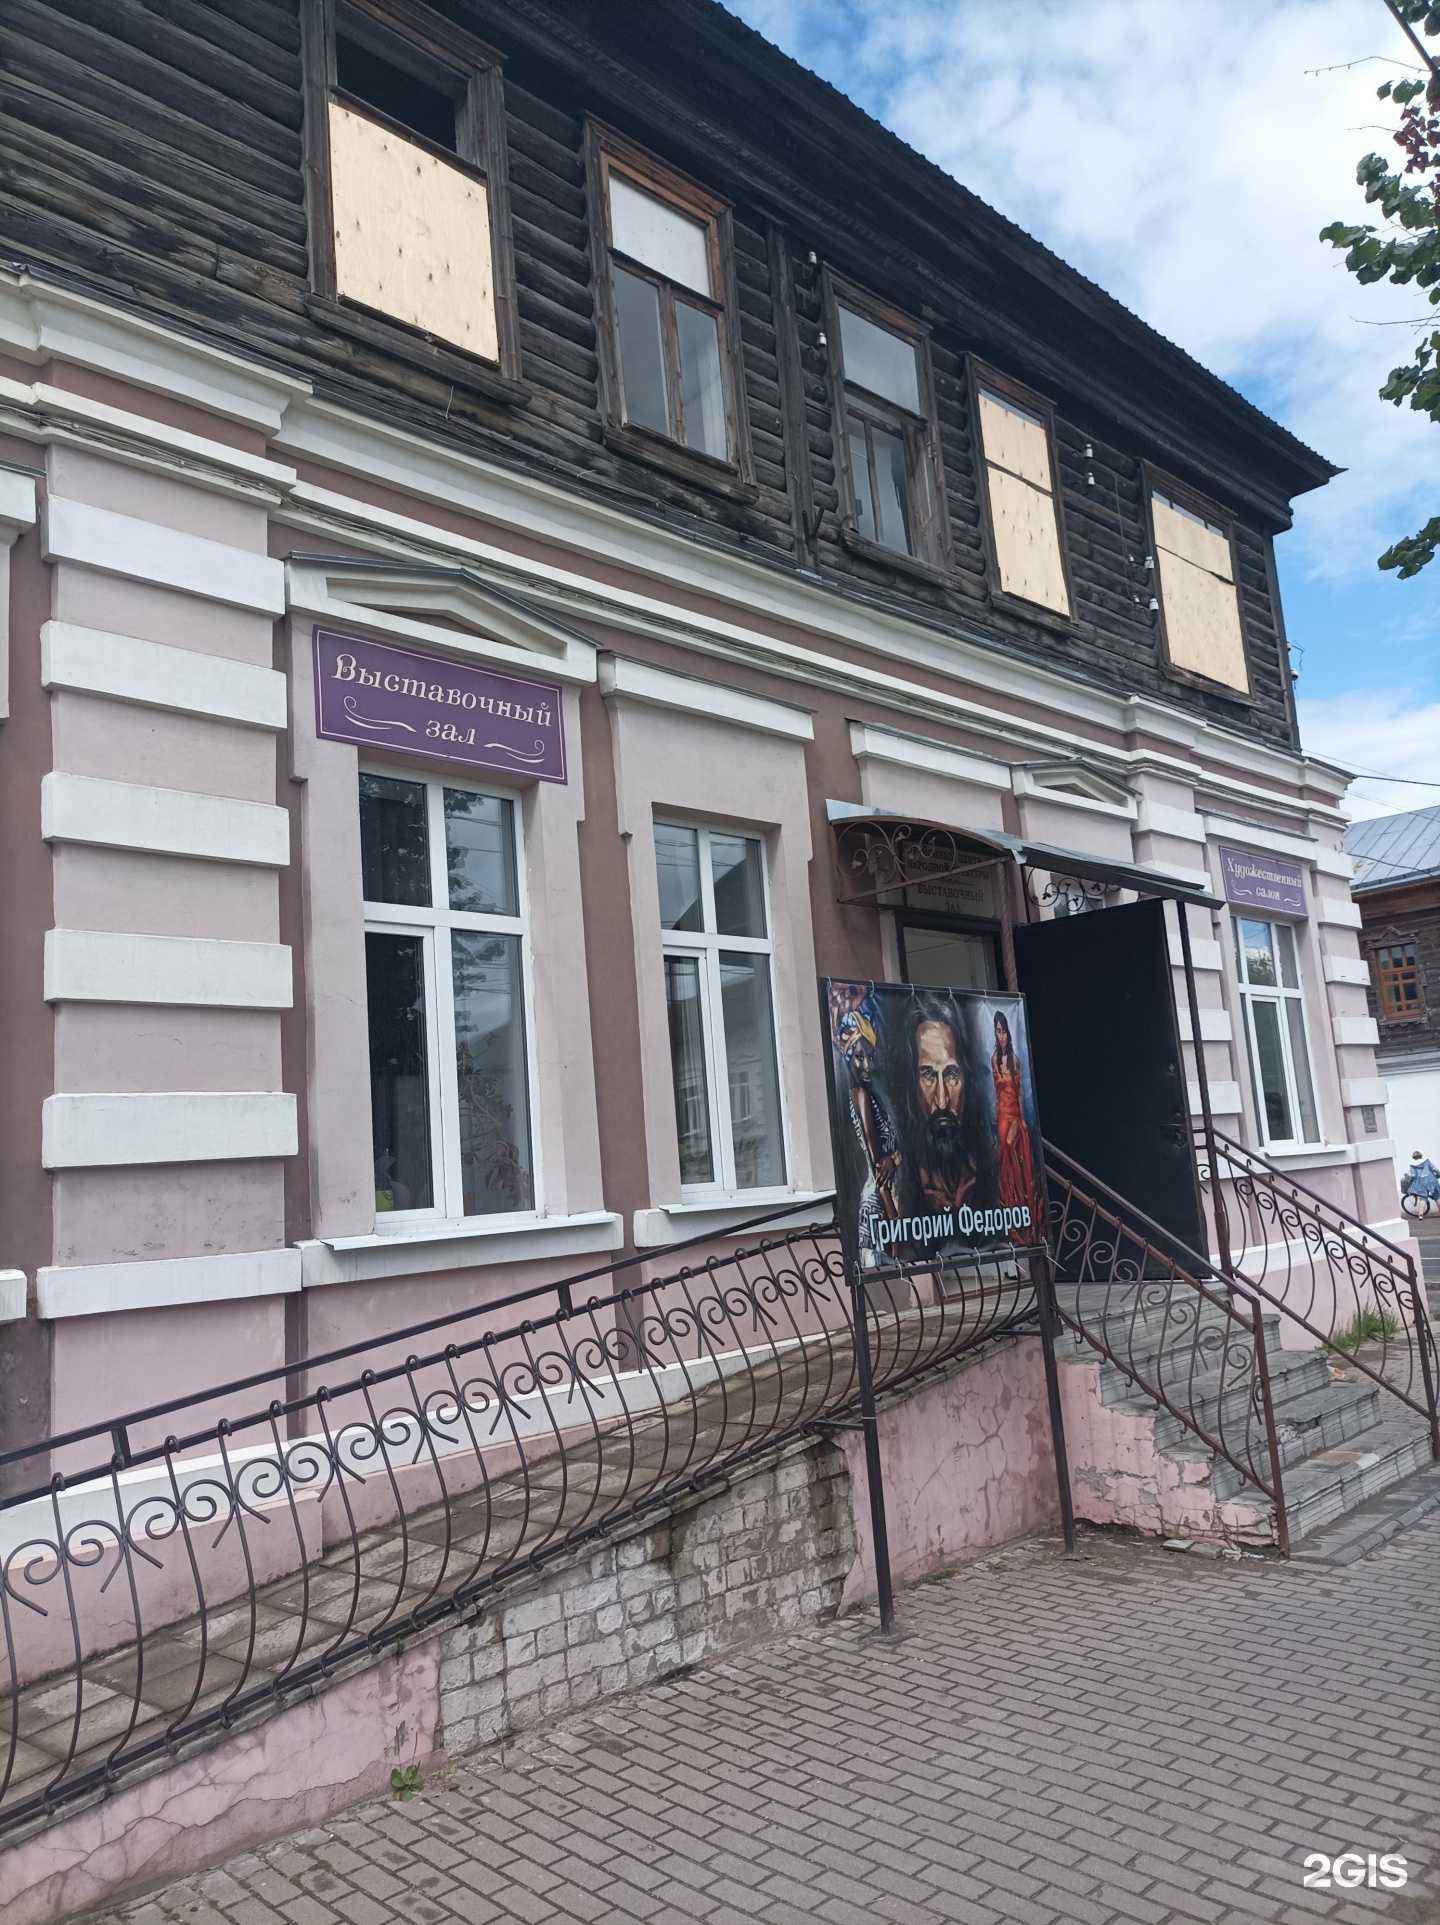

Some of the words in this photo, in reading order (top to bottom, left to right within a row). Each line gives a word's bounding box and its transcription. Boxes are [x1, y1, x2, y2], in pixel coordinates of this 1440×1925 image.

[331, 653, 552, 727] Выставочный
[425, 719, 477, 745] зал
[1256, 887, 1280, 901] салон
[869, 1206, 954, 1250] Григорий
[958, 1203, 1031, 1236] Федоров
